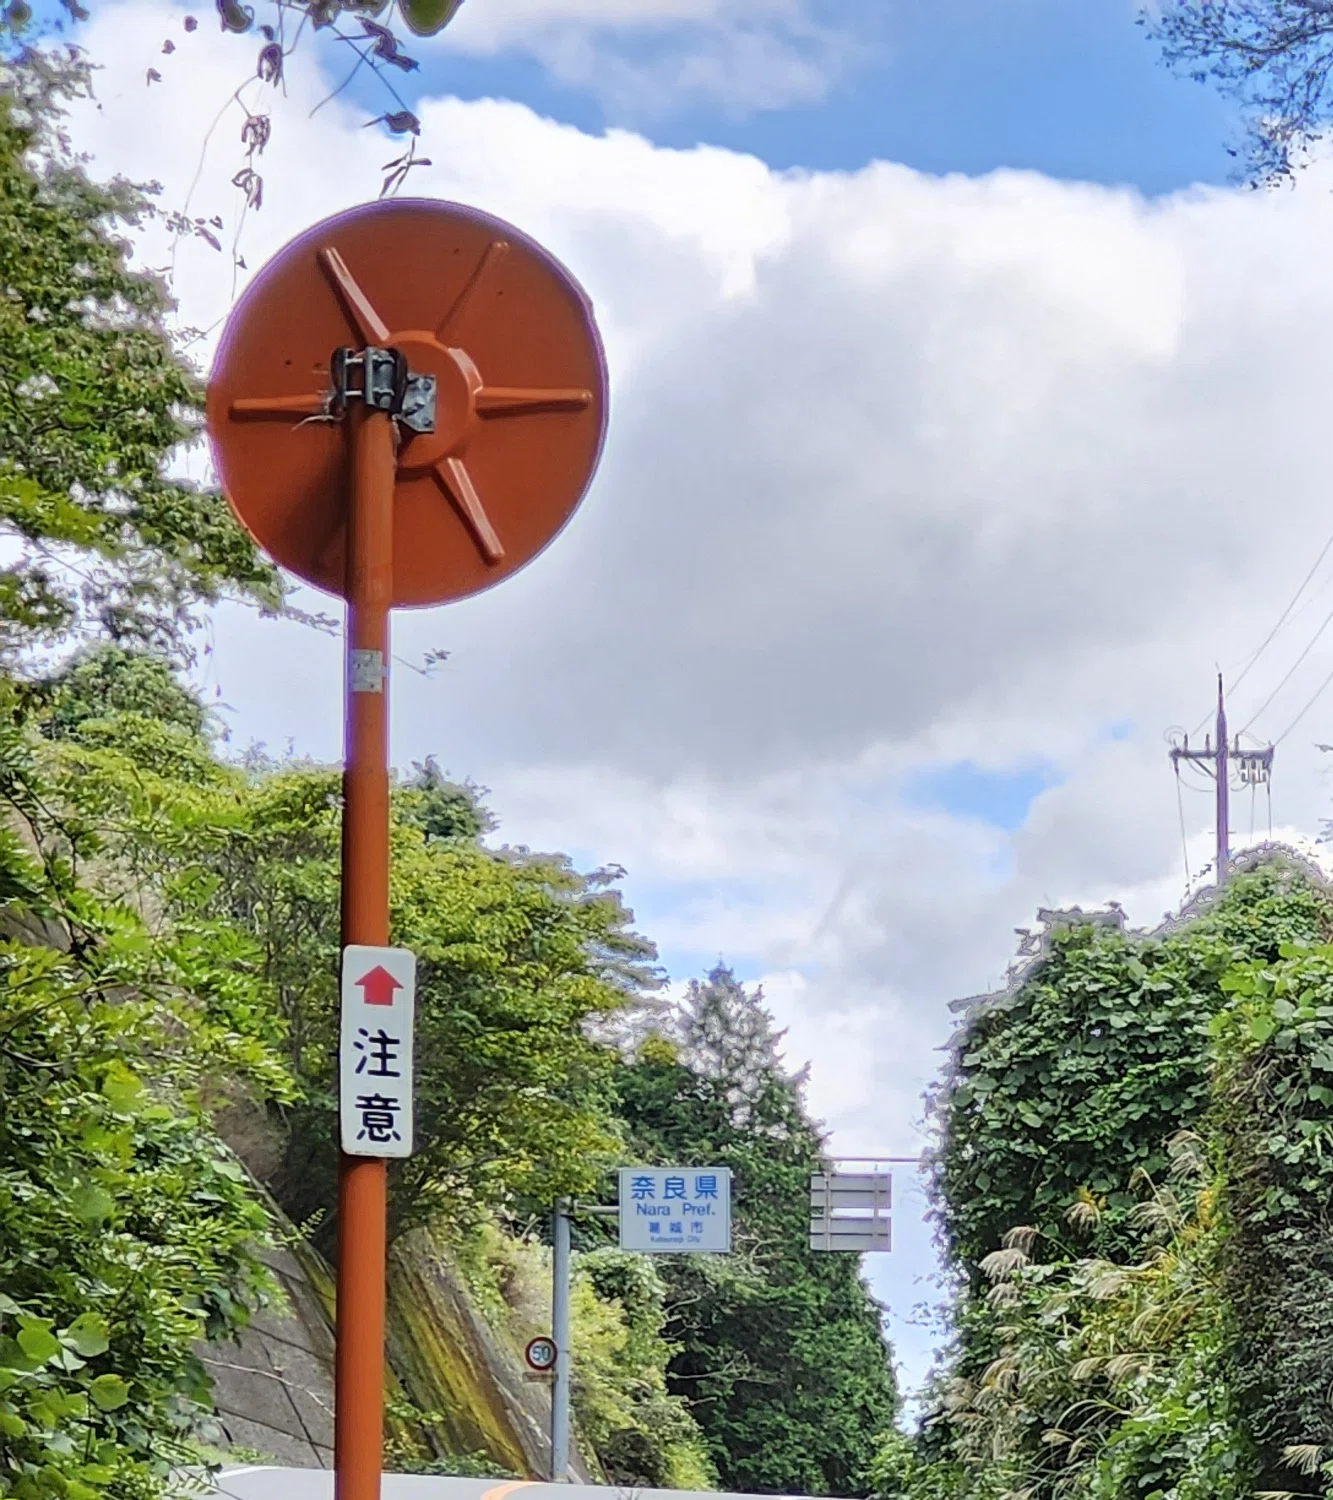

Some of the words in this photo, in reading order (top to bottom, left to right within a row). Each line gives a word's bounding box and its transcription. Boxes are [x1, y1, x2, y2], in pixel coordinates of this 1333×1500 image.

[353, 1028, 401, 1142] 注意
[631, 1175, 718, 1200] 奈良県
[636, 1203, 671, 1216] Nara
[683, 1202, 716, 1216] Pref.
[533, 1345, 550, 1361] 50
